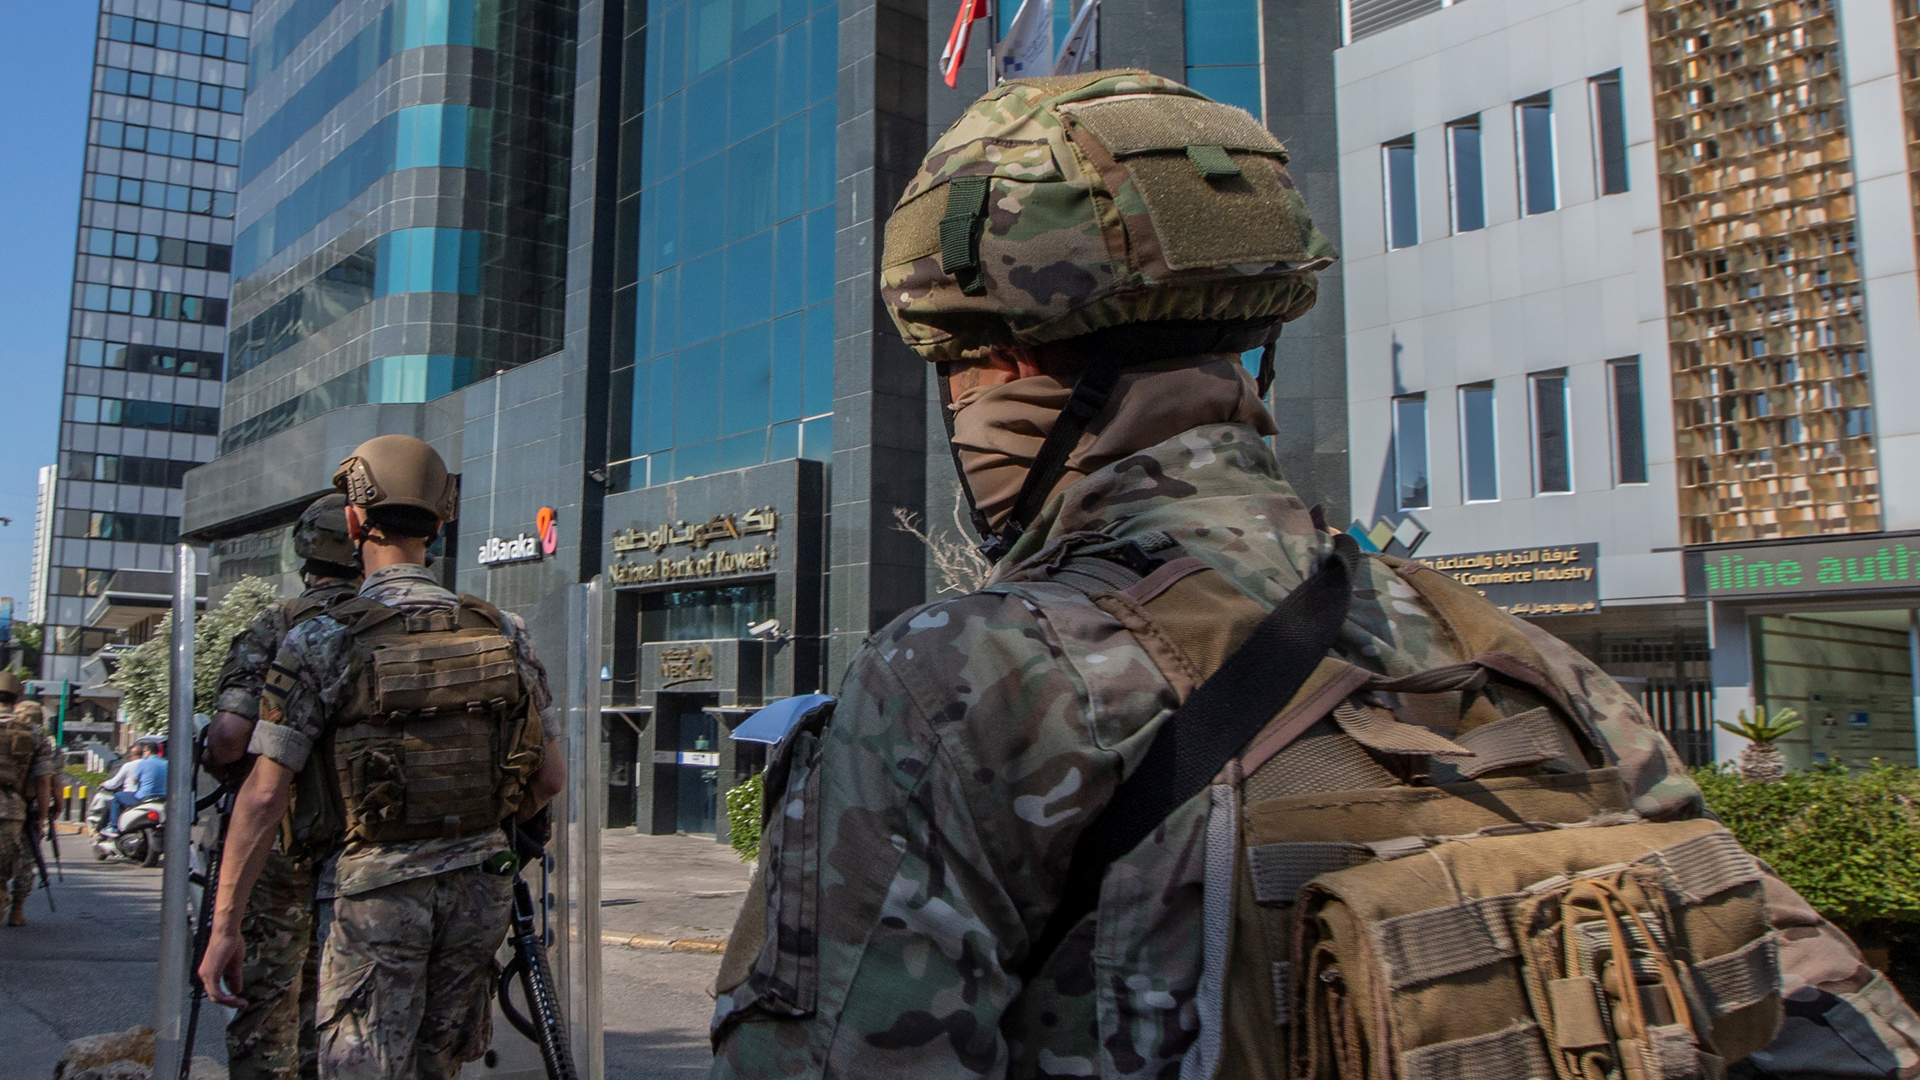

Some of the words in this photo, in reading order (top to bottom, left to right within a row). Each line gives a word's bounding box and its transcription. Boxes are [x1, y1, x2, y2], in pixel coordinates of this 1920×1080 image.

[477, 533, 537, 565] alBaraka
[1541, 547, 1580, 564] غرفة
[661, 555, 695, 579] Bank
[696, 551, 714, 575] of
[715, 545, 768, 573] Kuwait
[1436, 554, 1493, 570] والصناعة
[1495, 550, 1540, 568] التجارة
[1461, 571, 1532, 586] Commerce
[1533, 566, 1594, 581] Industry
